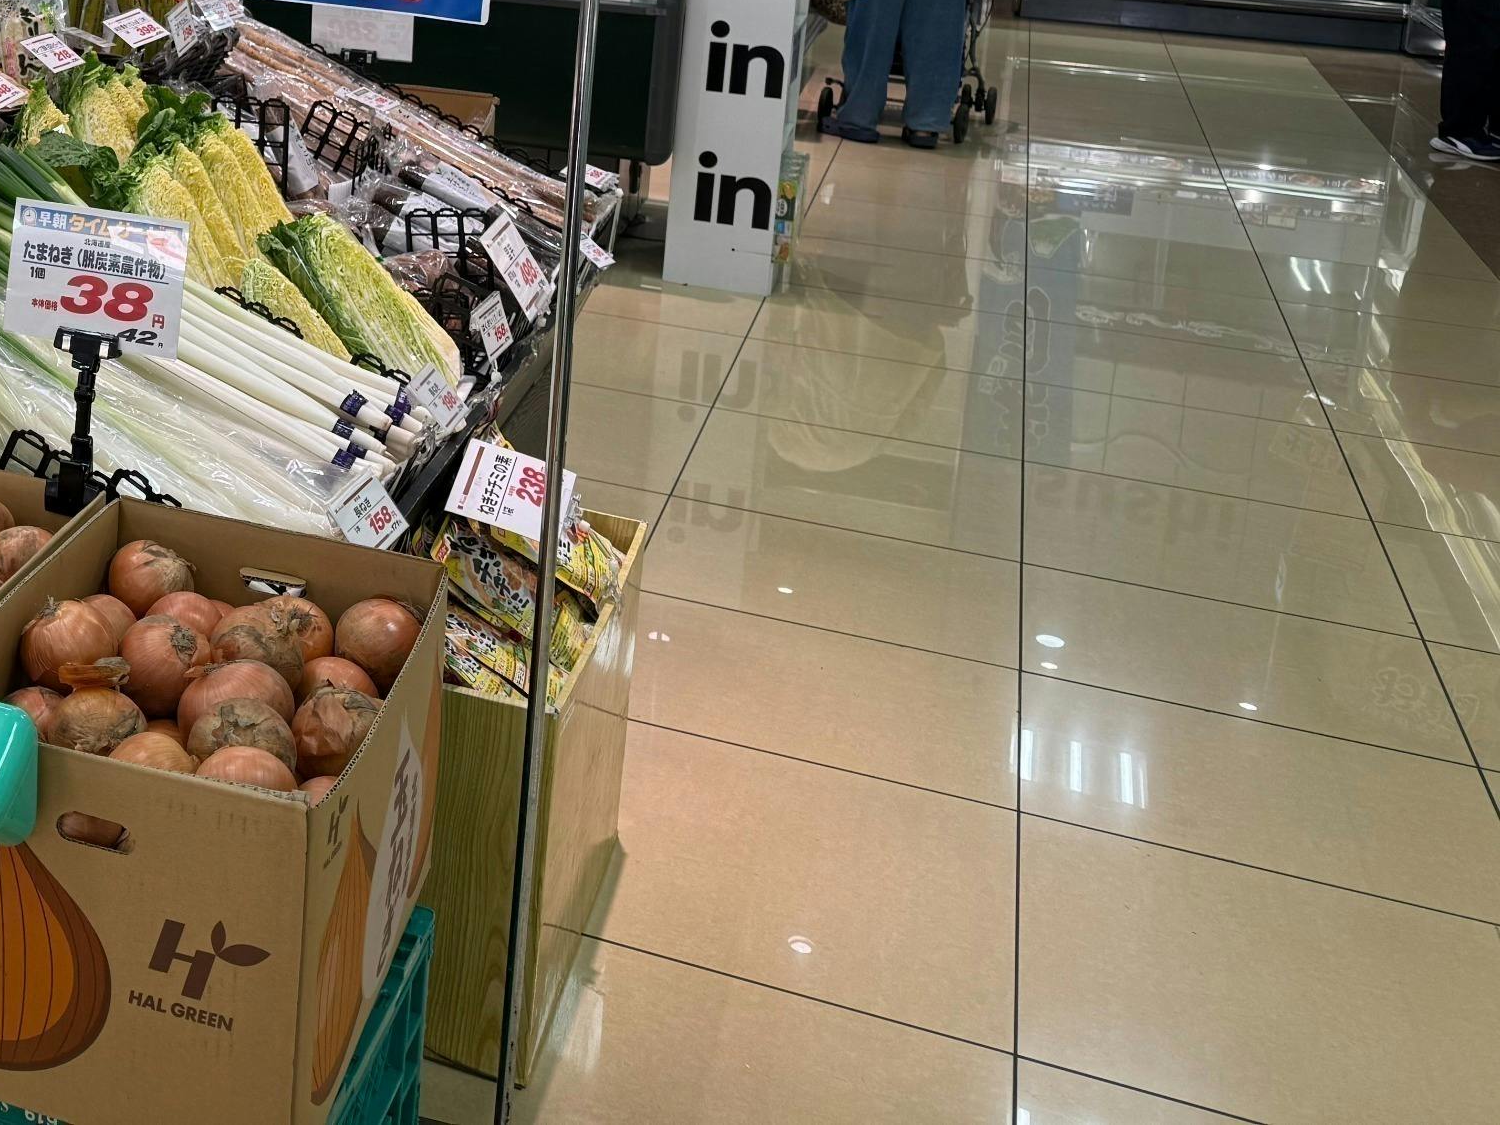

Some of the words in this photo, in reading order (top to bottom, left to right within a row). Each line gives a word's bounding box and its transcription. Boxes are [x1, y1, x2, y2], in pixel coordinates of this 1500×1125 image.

[705, 20, 785, 99] in
[693, 150, 773, 231] in
[128, 990, 167, 1013] HAL
[170, 1003, 234, 1032] GREEN
